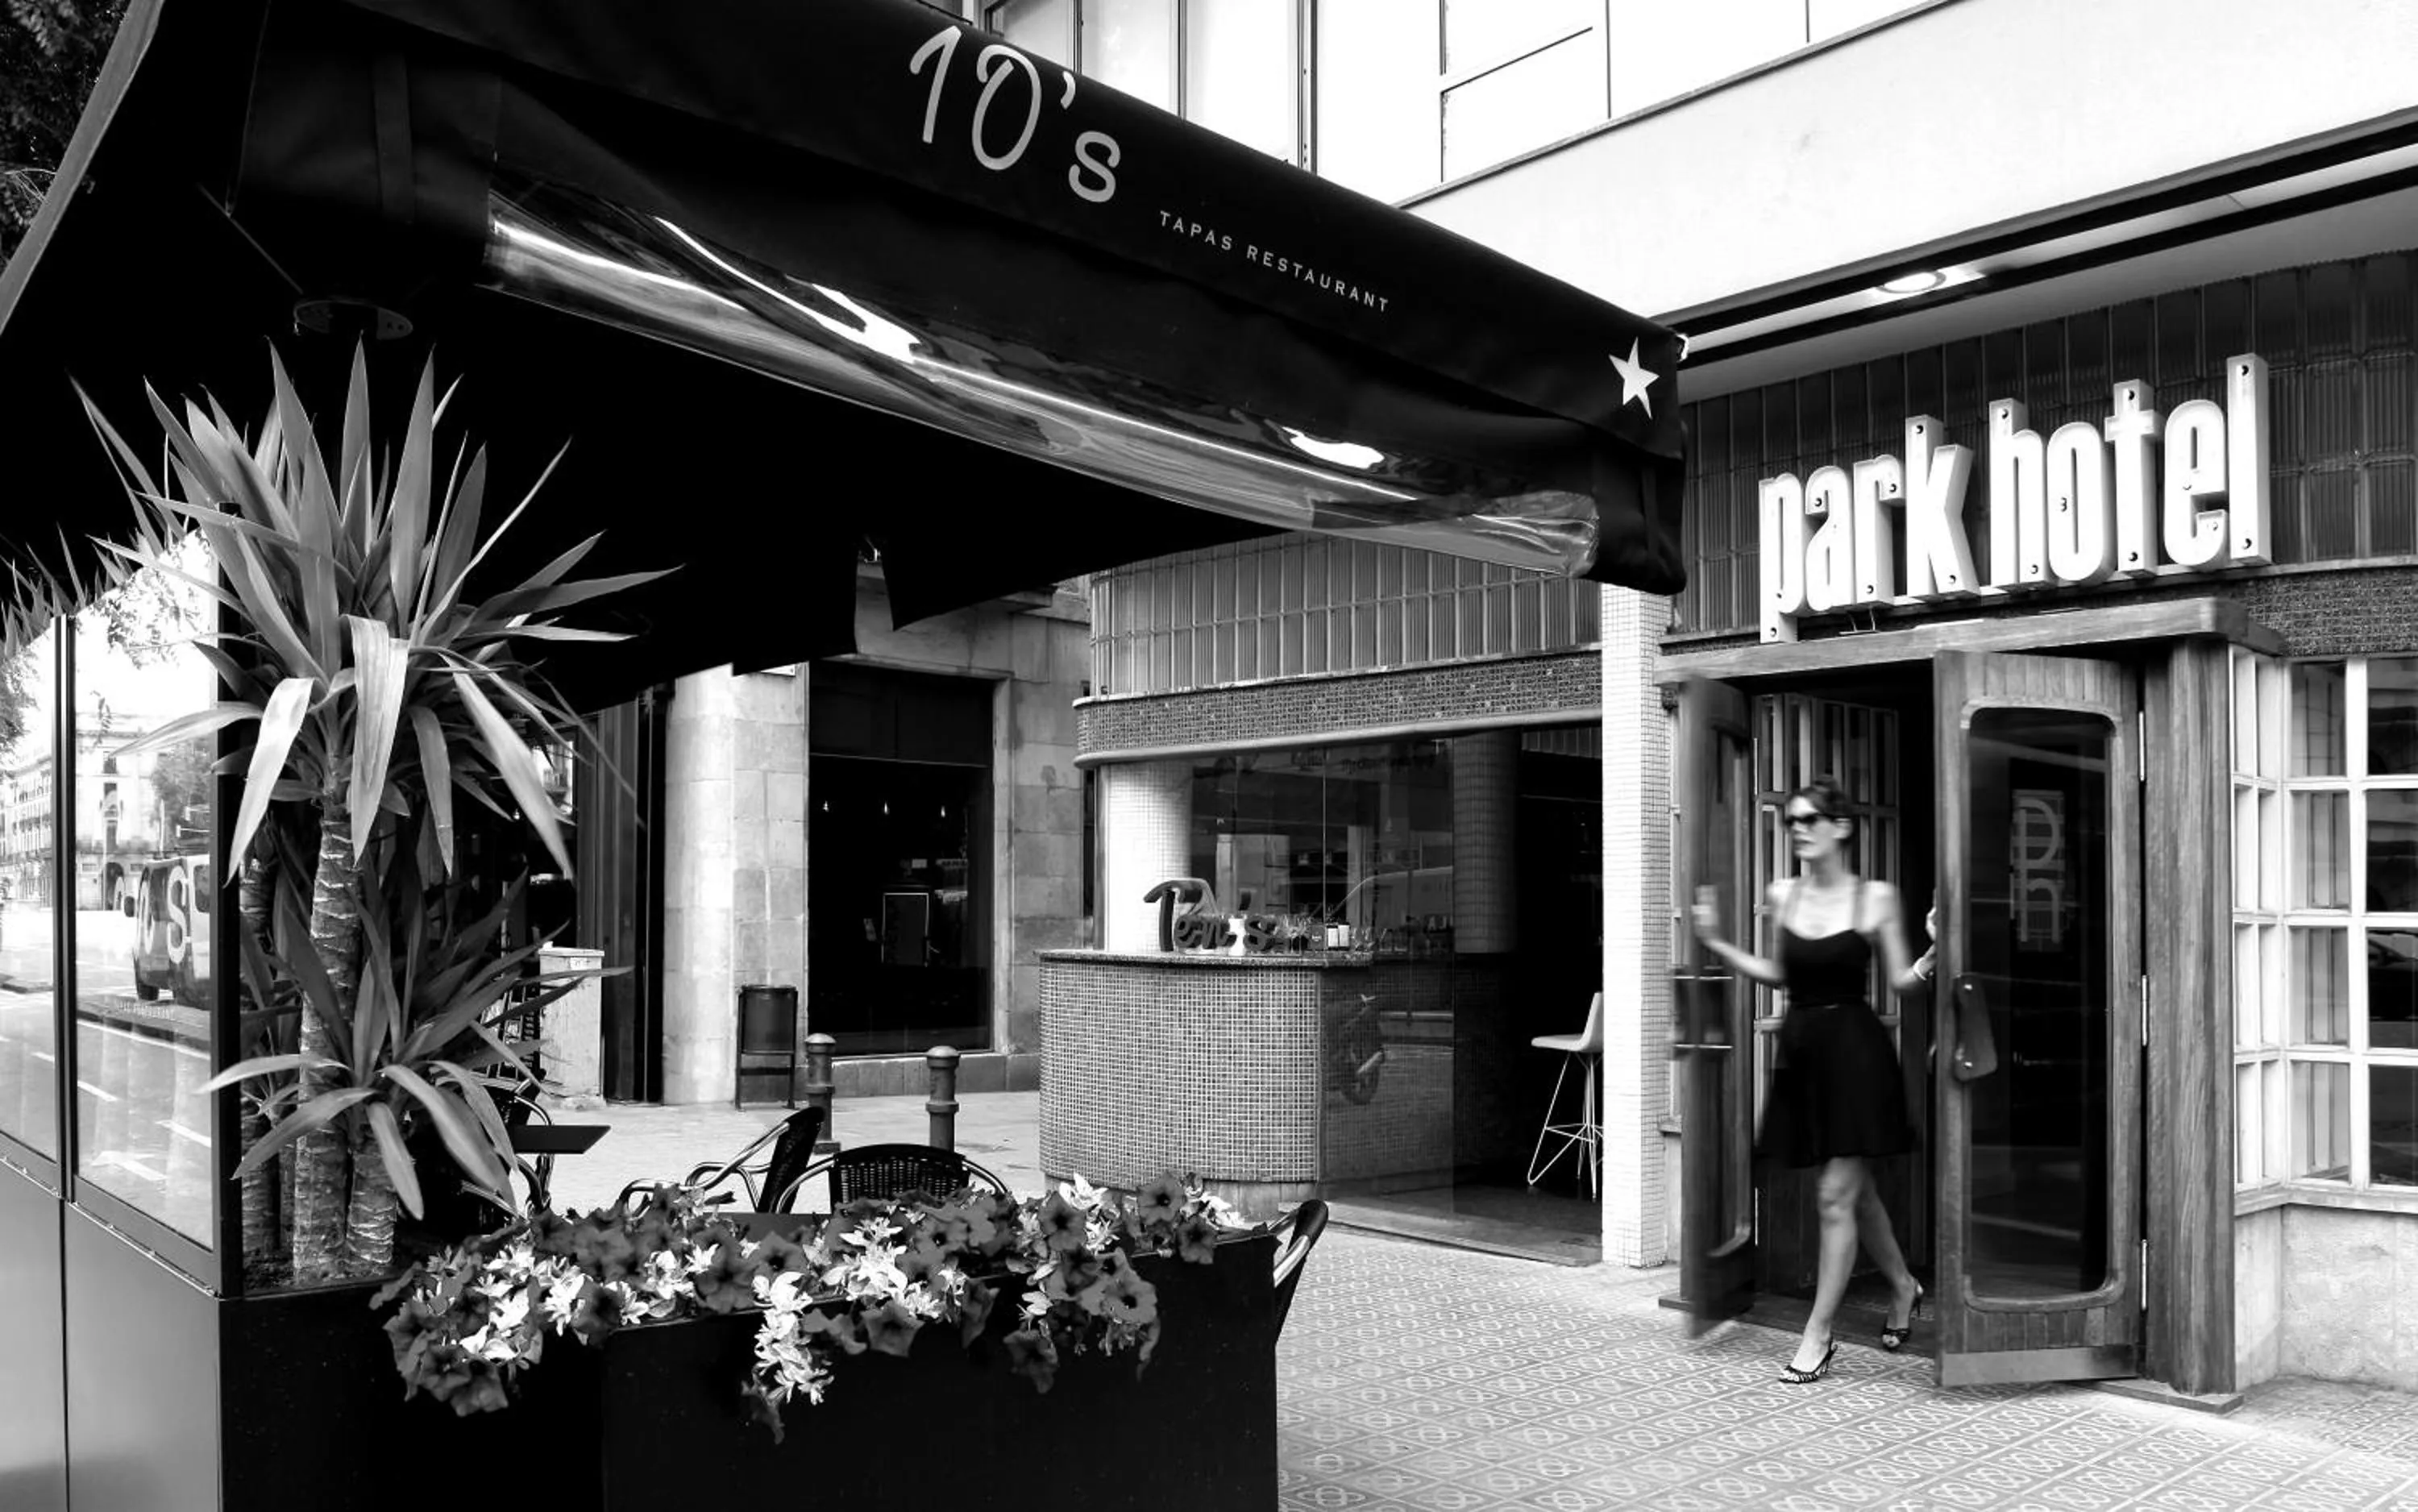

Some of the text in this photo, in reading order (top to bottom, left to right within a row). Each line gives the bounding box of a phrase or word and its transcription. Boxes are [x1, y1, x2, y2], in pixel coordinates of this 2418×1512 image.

[909, 25, 1120, 203] 10's
[1159, 210, 1390, 314] TAPAS RESTAURANT
[1758, 352, 2272, 644] park hotel
